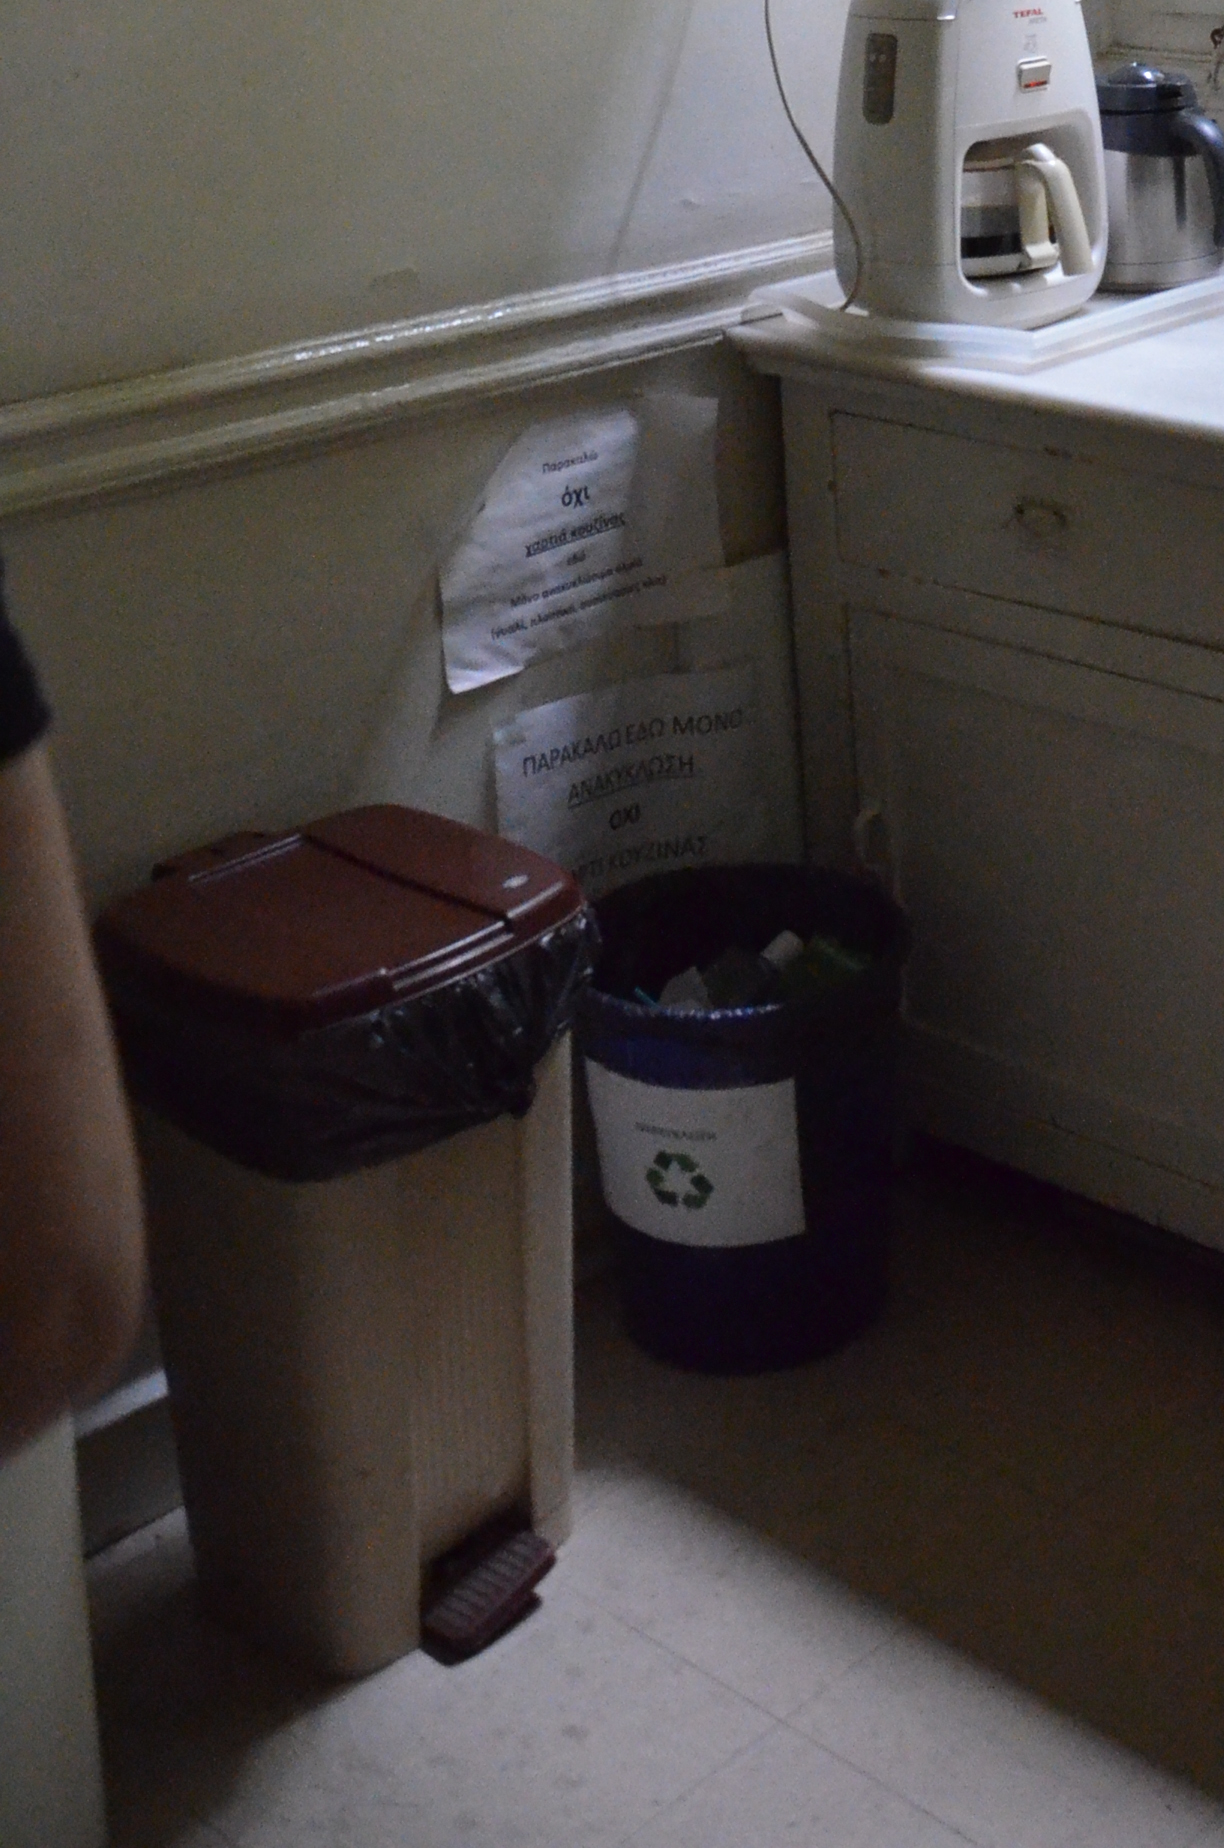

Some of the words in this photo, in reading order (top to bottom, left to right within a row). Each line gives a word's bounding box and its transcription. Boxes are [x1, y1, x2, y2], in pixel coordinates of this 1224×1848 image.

[1013, 7, 1043, 19] TEFAL
[542, 452, 599, 474] Παρακαλώ
[561, 484, 590, 508] όχι
[525, 529, 568, 558] χαρτιά
[571, 511, 627, 542] κουζίνας
[522, 729, 621, 777] ΠΑΡΑΚΑΛΩ
[625, 717, 665, 745] ΕΔΩ
[672, 708, 744, 735] ΜΟΝΟ
[567, 754, 695, 807] ΑΝΑΚΥΚΛΩΣΗ
[608, 803, 641, 831] ΟΧΙ
[608, 835, 708, 869] ΚΟΥΖΙΝΑΣ
